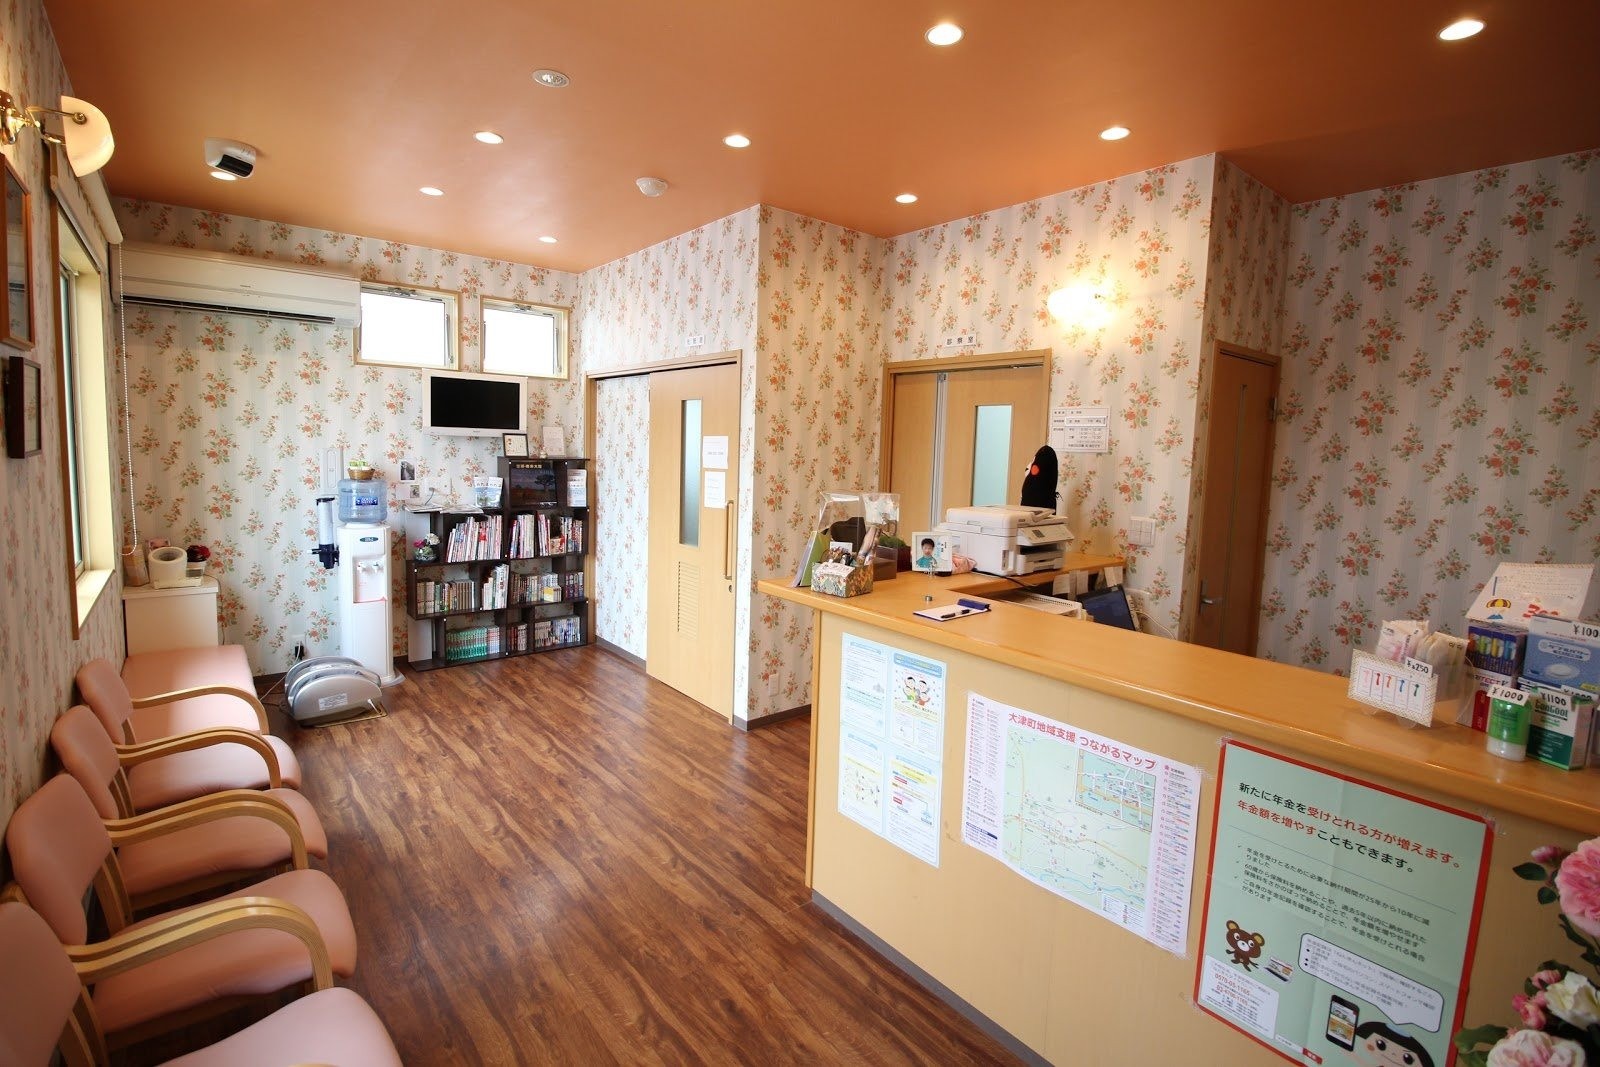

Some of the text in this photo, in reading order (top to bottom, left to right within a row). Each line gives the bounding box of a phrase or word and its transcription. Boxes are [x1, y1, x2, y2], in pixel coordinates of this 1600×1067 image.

[1492, 687, 1524, 701] ¥1000
[1540, 692, 1567, 706] ¥1100
[1008, 712, 1157, 769] 大津町地域支援 つながるマップ
[1237, 799, 1414, 873] 年金額を増やすこともできます。
[1238, 781, 1460, 869] 新たに年金を受けとれる方が増えます。
